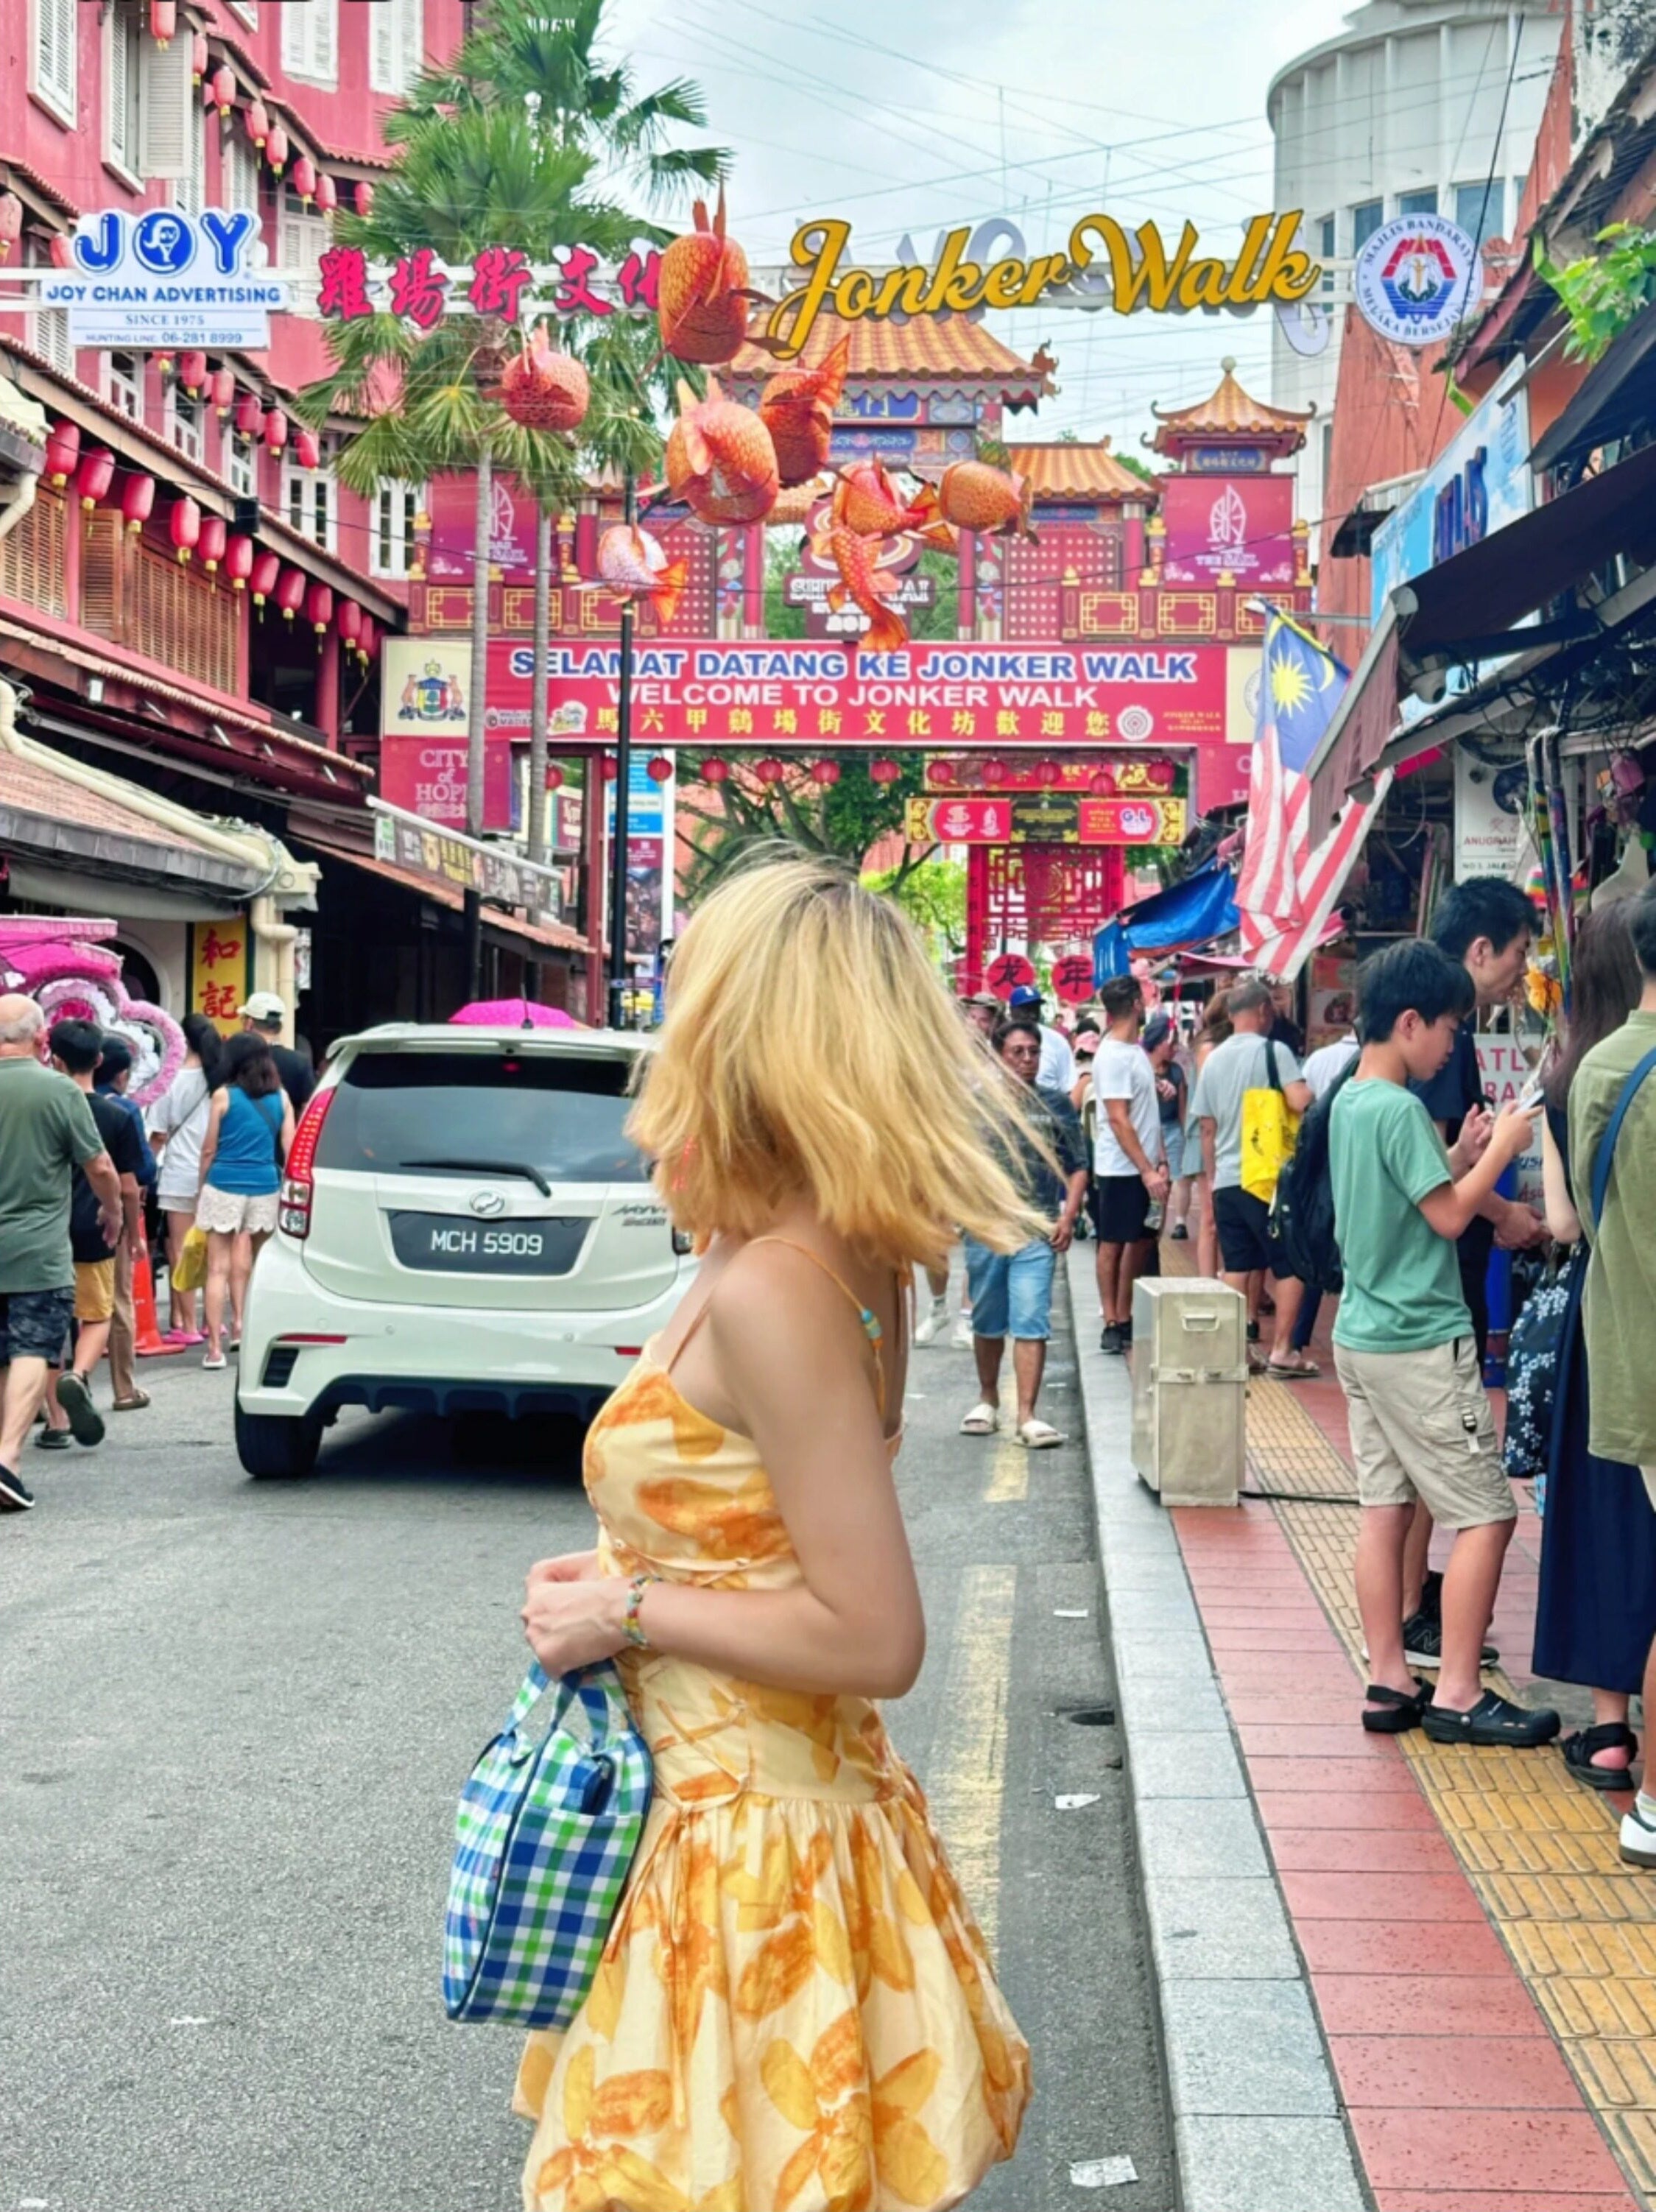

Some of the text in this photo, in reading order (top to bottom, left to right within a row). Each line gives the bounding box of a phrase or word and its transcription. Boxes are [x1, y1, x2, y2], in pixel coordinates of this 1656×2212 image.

[74, 212, 252, 275] JOY
[1365, 224, 1404, 265] MAJLIS
[47, 286, 281, 303] JOY CHAN ADVERTISING
[768, 208, 1322, 361] Jonker Walk
[126, 314, 205, 326] SINCE 1975
[697, 652, 845, 678] DATANG
[859, 653, 909, 678] KE
[920, 654, 1074, 679] JONKER
[1084, 655, 1195, 680] WALK
[607, 683, 1099, 708] WELCOME TO JONKER WALK
[437, 768, 456, 783] of
[430, 1229, 543, 1255] MCH 5909
